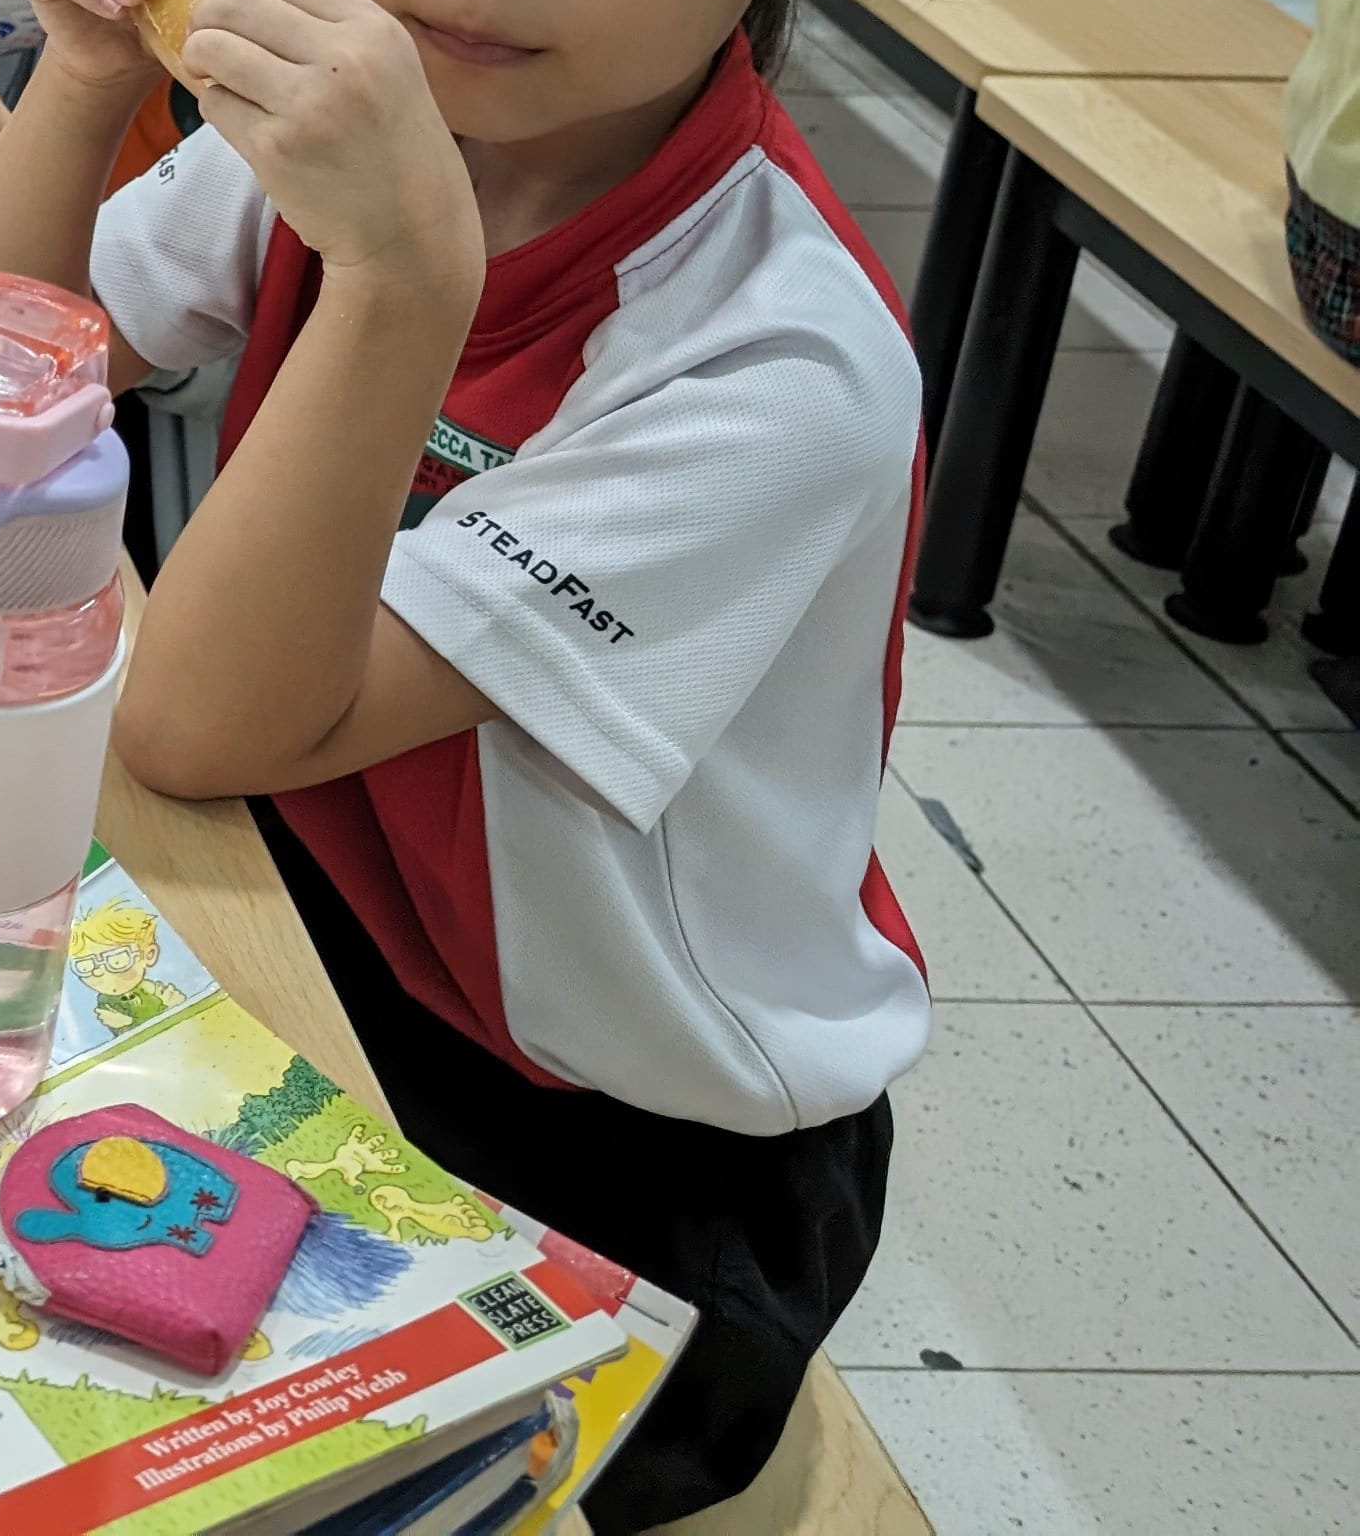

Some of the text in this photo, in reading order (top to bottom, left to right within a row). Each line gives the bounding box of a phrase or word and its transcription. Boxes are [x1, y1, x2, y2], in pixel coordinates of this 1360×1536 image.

[457, 511, 634, 644] STEADFAST
[470, 1278, 526, 1312] CLEAN
[487, 1294, 542, 1328] SLATE
[502, 1308, 559, 1344] PRESS
[134, 1368, 408, 1491] Illustrations by Philip Webb
[143, 1362, 361, 1460] Written by Joy Cowley
